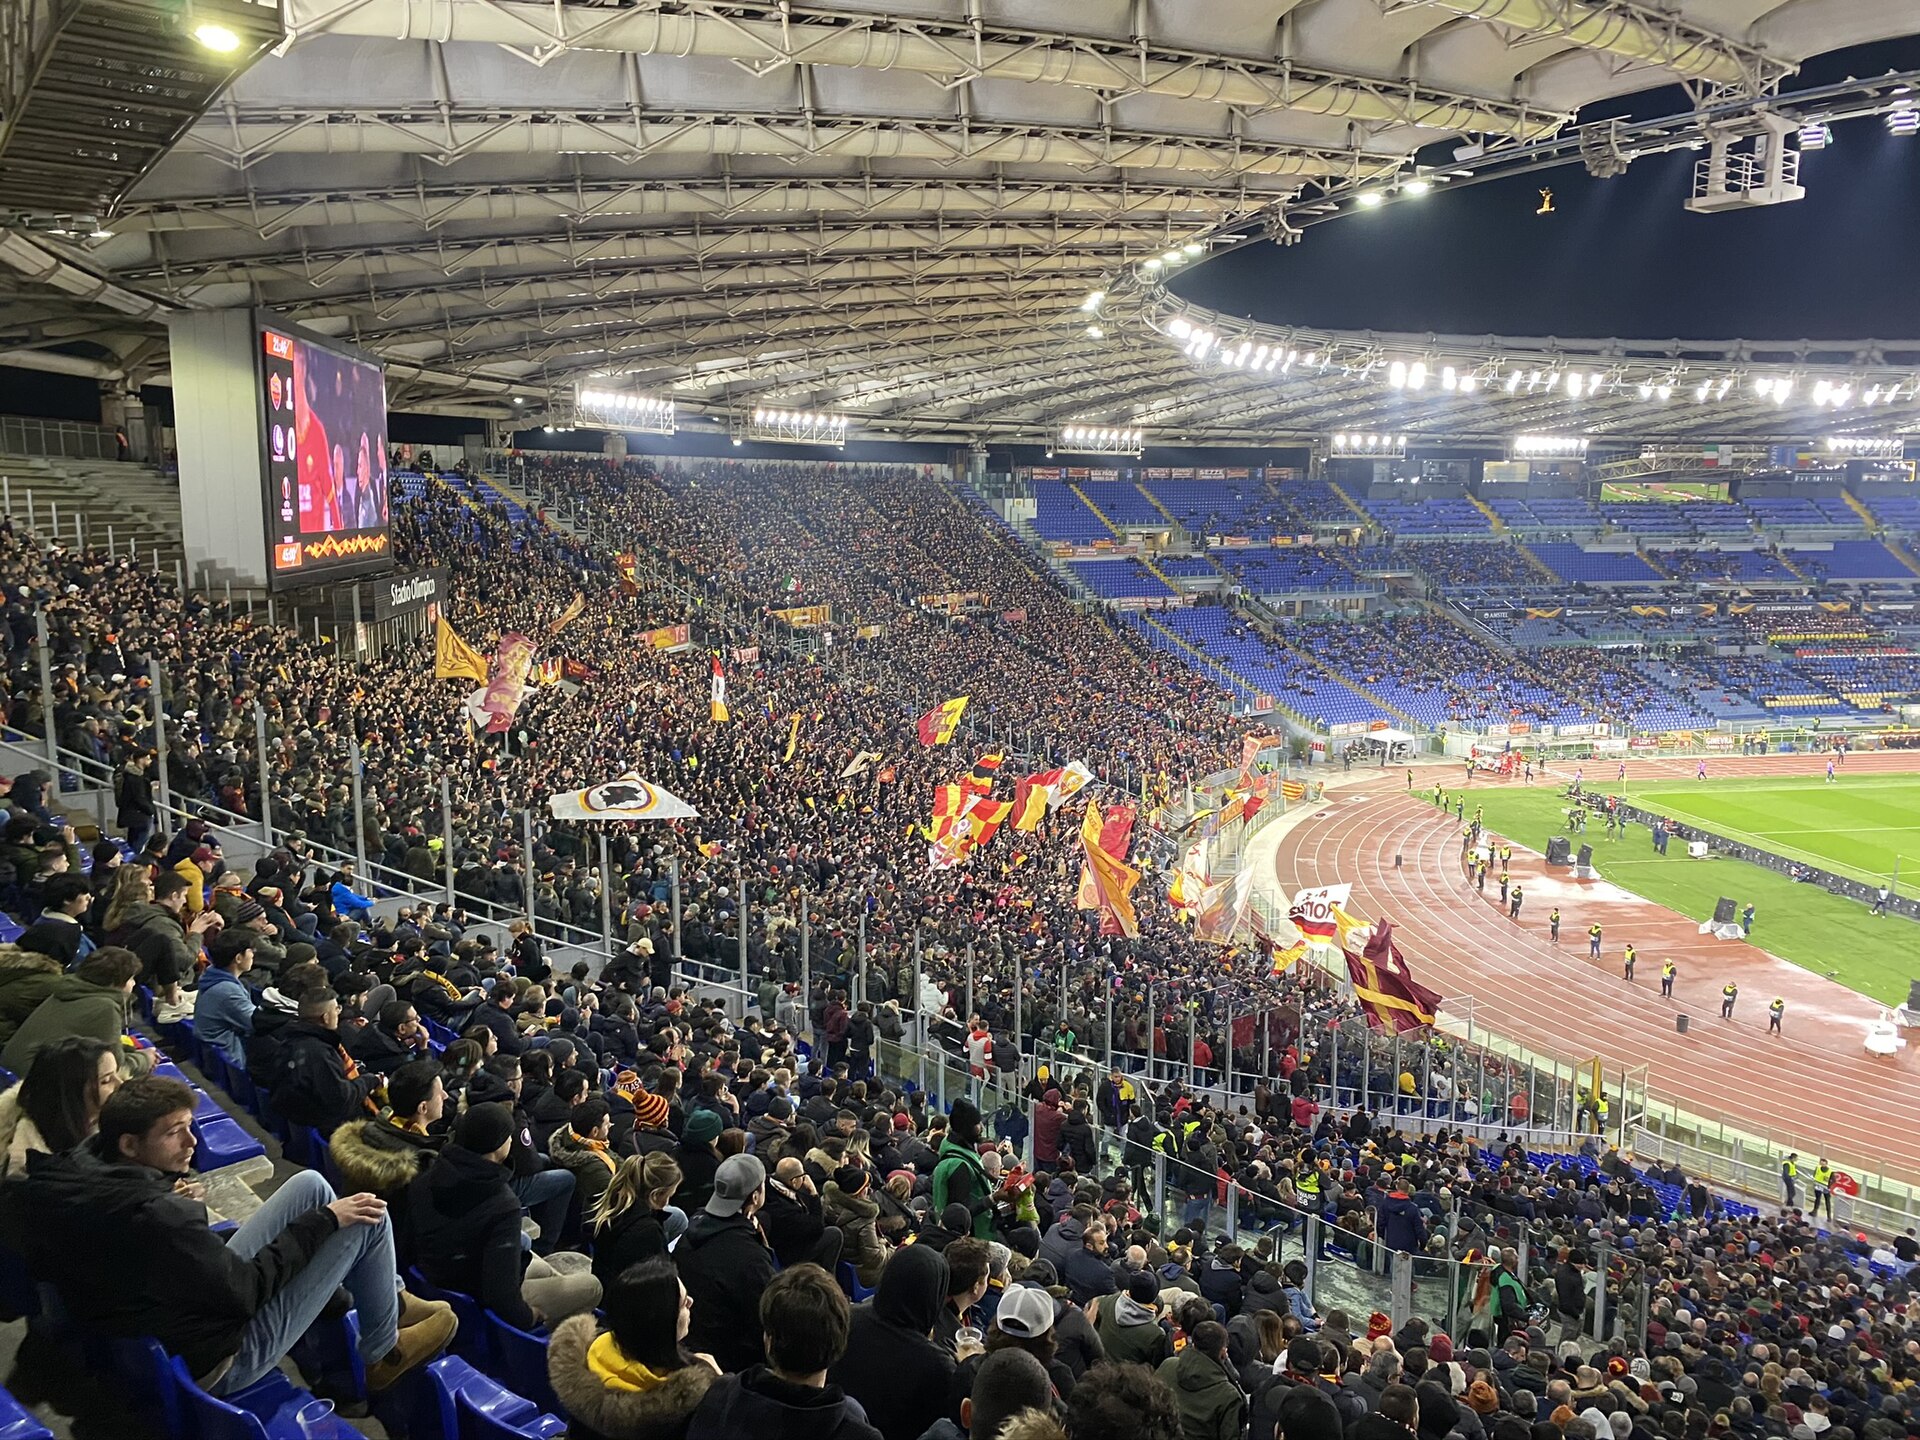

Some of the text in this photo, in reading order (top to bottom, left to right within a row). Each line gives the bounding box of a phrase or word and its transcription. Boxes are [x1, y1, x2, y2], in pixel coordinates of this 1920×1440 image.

[286, 377, 293, 410] 1
[287, 427, 295, 460] 0
[391, 574, 435, 606] Stadio Olimpico
[1834, 1173, 1852, 1187] 22
